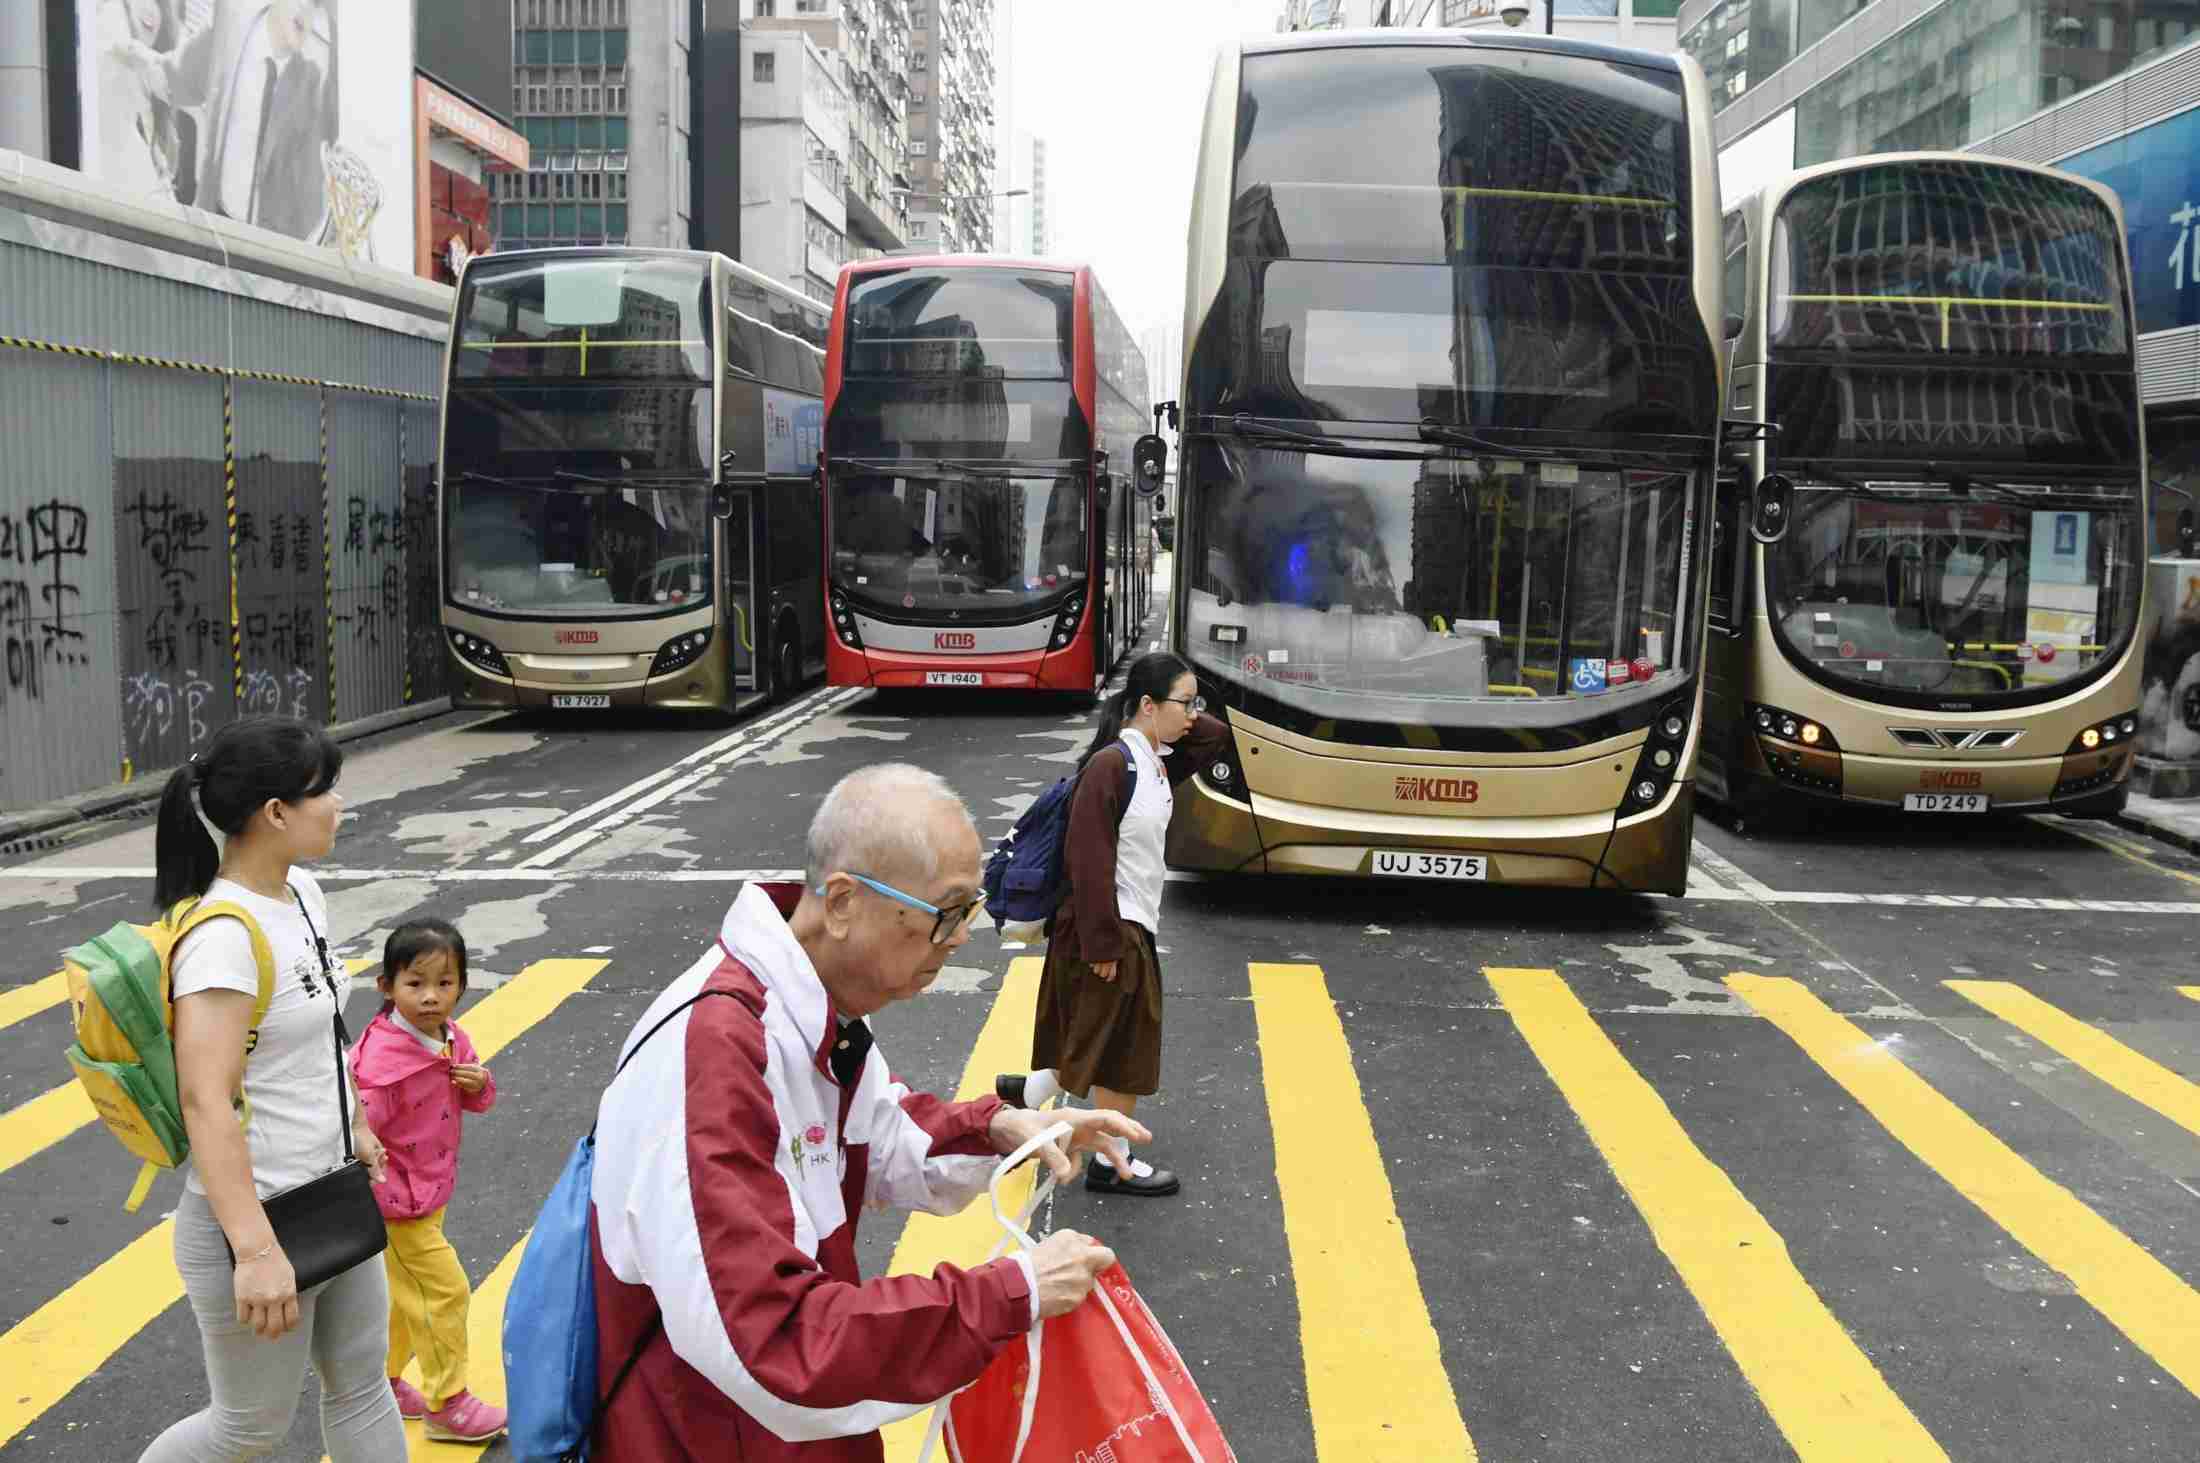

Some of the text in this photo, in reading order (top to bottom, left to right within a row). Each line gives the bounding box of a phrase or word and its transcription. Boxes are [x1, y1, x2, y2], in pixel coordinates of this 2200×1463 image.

[934, 632, 976, 649] KMB
[931, 673, 978, 684] VT 1940
[576, 695, 606, 706] 7927
[1936, 770, 1982, 789] KMB
[1418, 778, 1479, 803] KMB
[1915, 795, 1978, 810] TD 249
[1380, 854, 1480, 877] UJ 3575
[810, 1152, 831, 1167] HK
